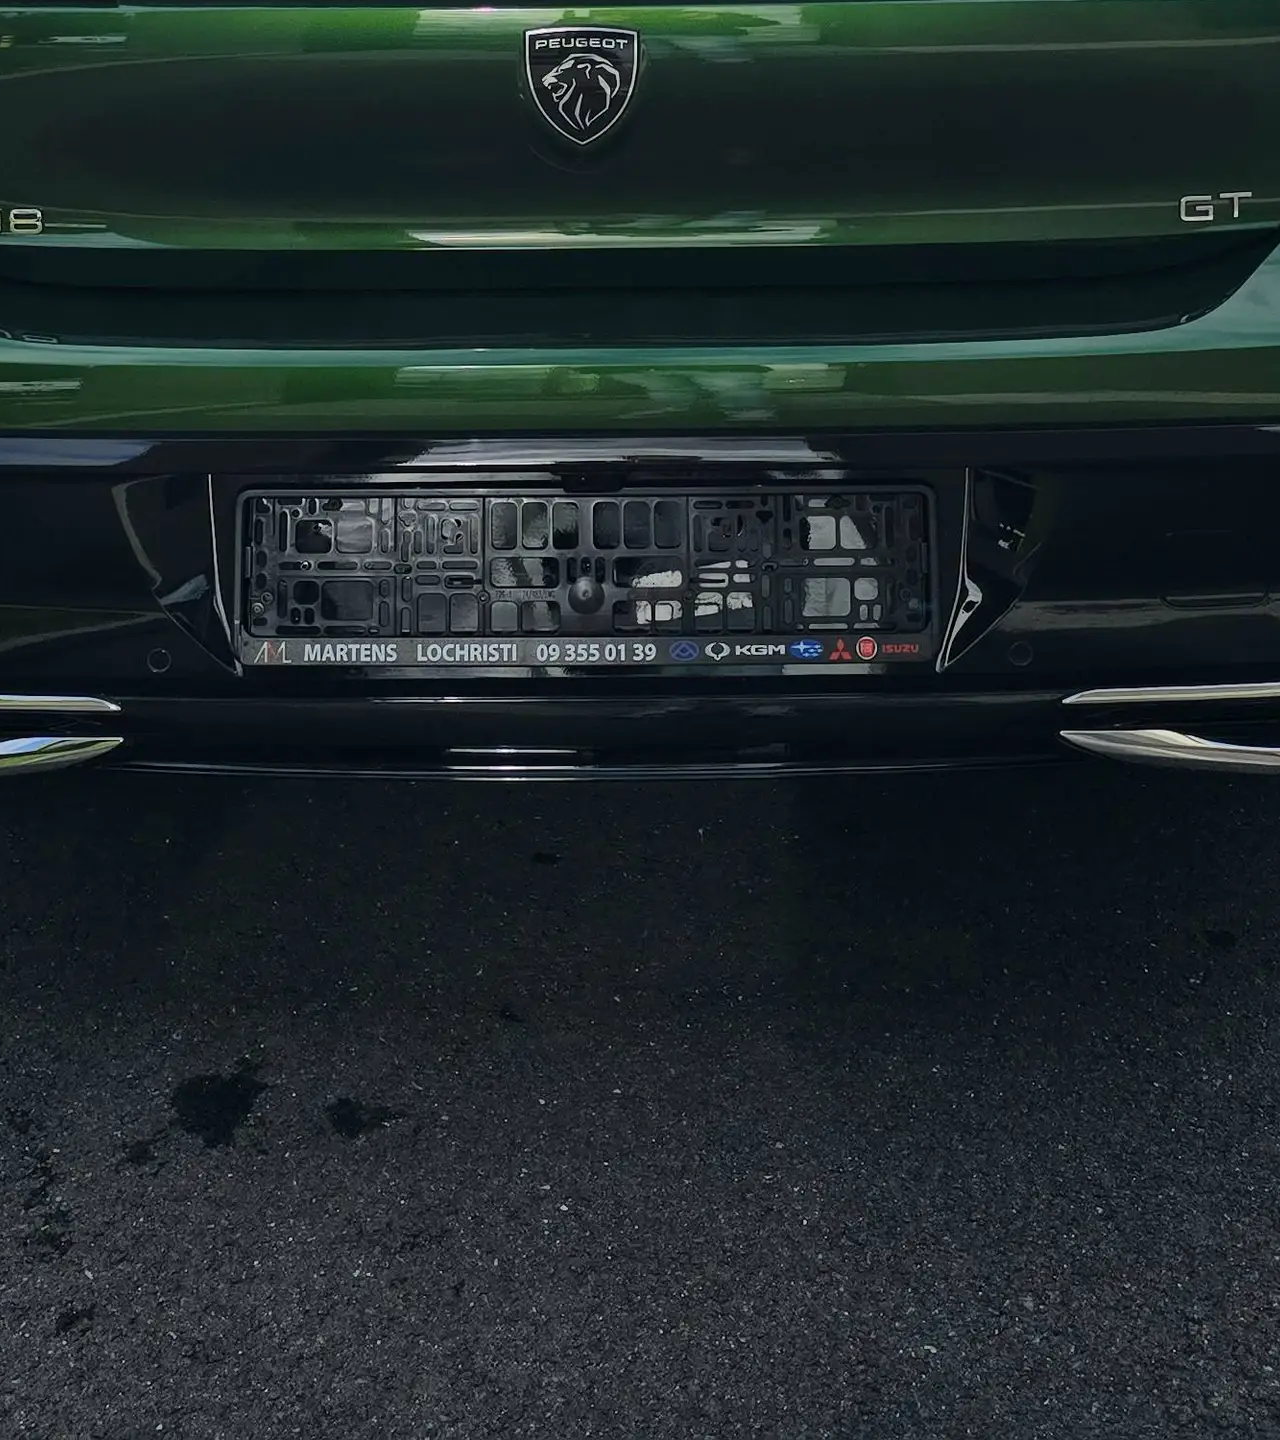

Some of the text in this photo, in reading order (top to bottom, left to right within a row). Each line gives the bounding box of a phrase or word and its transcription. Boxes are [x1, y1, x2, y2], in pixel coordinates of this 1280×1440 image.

[535, 38, 628, 50] PEUGEOT
[1180, 191, 1252, 221] GT
[304, 643, 397, 662] MARTENS
[417, 643, 517, 662] LOCHRISTI
[536, 643, 560, 662] 09
[564, 643, 600, 662] 355
[604, 643, 627, 662] 01
[632, 643, 657, 662] 39
[735, 644, 786, 656] KGM
[882, 643, 919, 654] ISUZU
